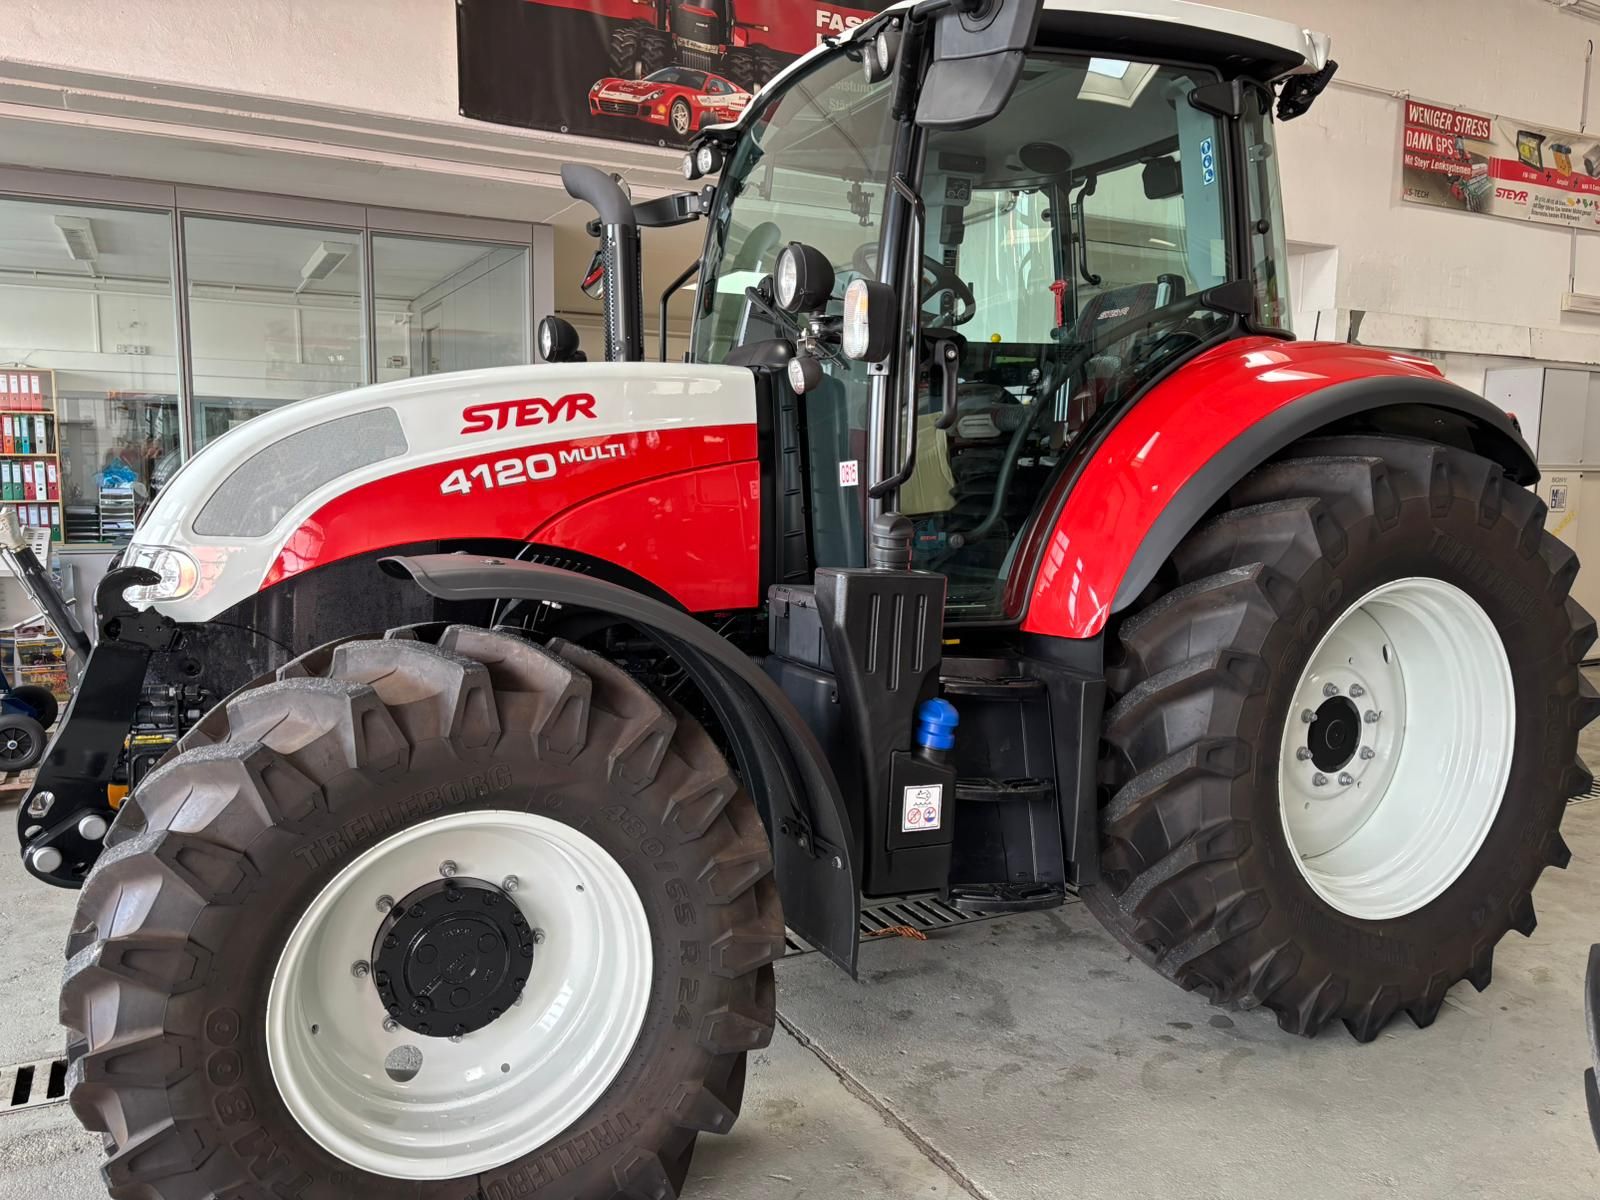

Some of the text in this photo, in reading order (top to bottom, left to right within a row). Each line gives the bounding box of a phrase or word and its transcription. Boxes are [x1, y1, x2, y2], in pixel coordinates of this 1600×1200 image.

[816, 9, 871, 33] FAS
[1409, 104, 1489, 138] WENIGER STRESS
[1406, 130, 1434, 152] DANK
[1413, 156, 1430, 170] Steyr
[1430, 158, 1472, 176] Lenksystemen
[1495, 188, 1528, 202] STEYR
[460, 393, 598, 435] STEYR
[439, 443, 627, 495] 4120 MULTI
[291, 762, 513, 870] TRELLEBORG
